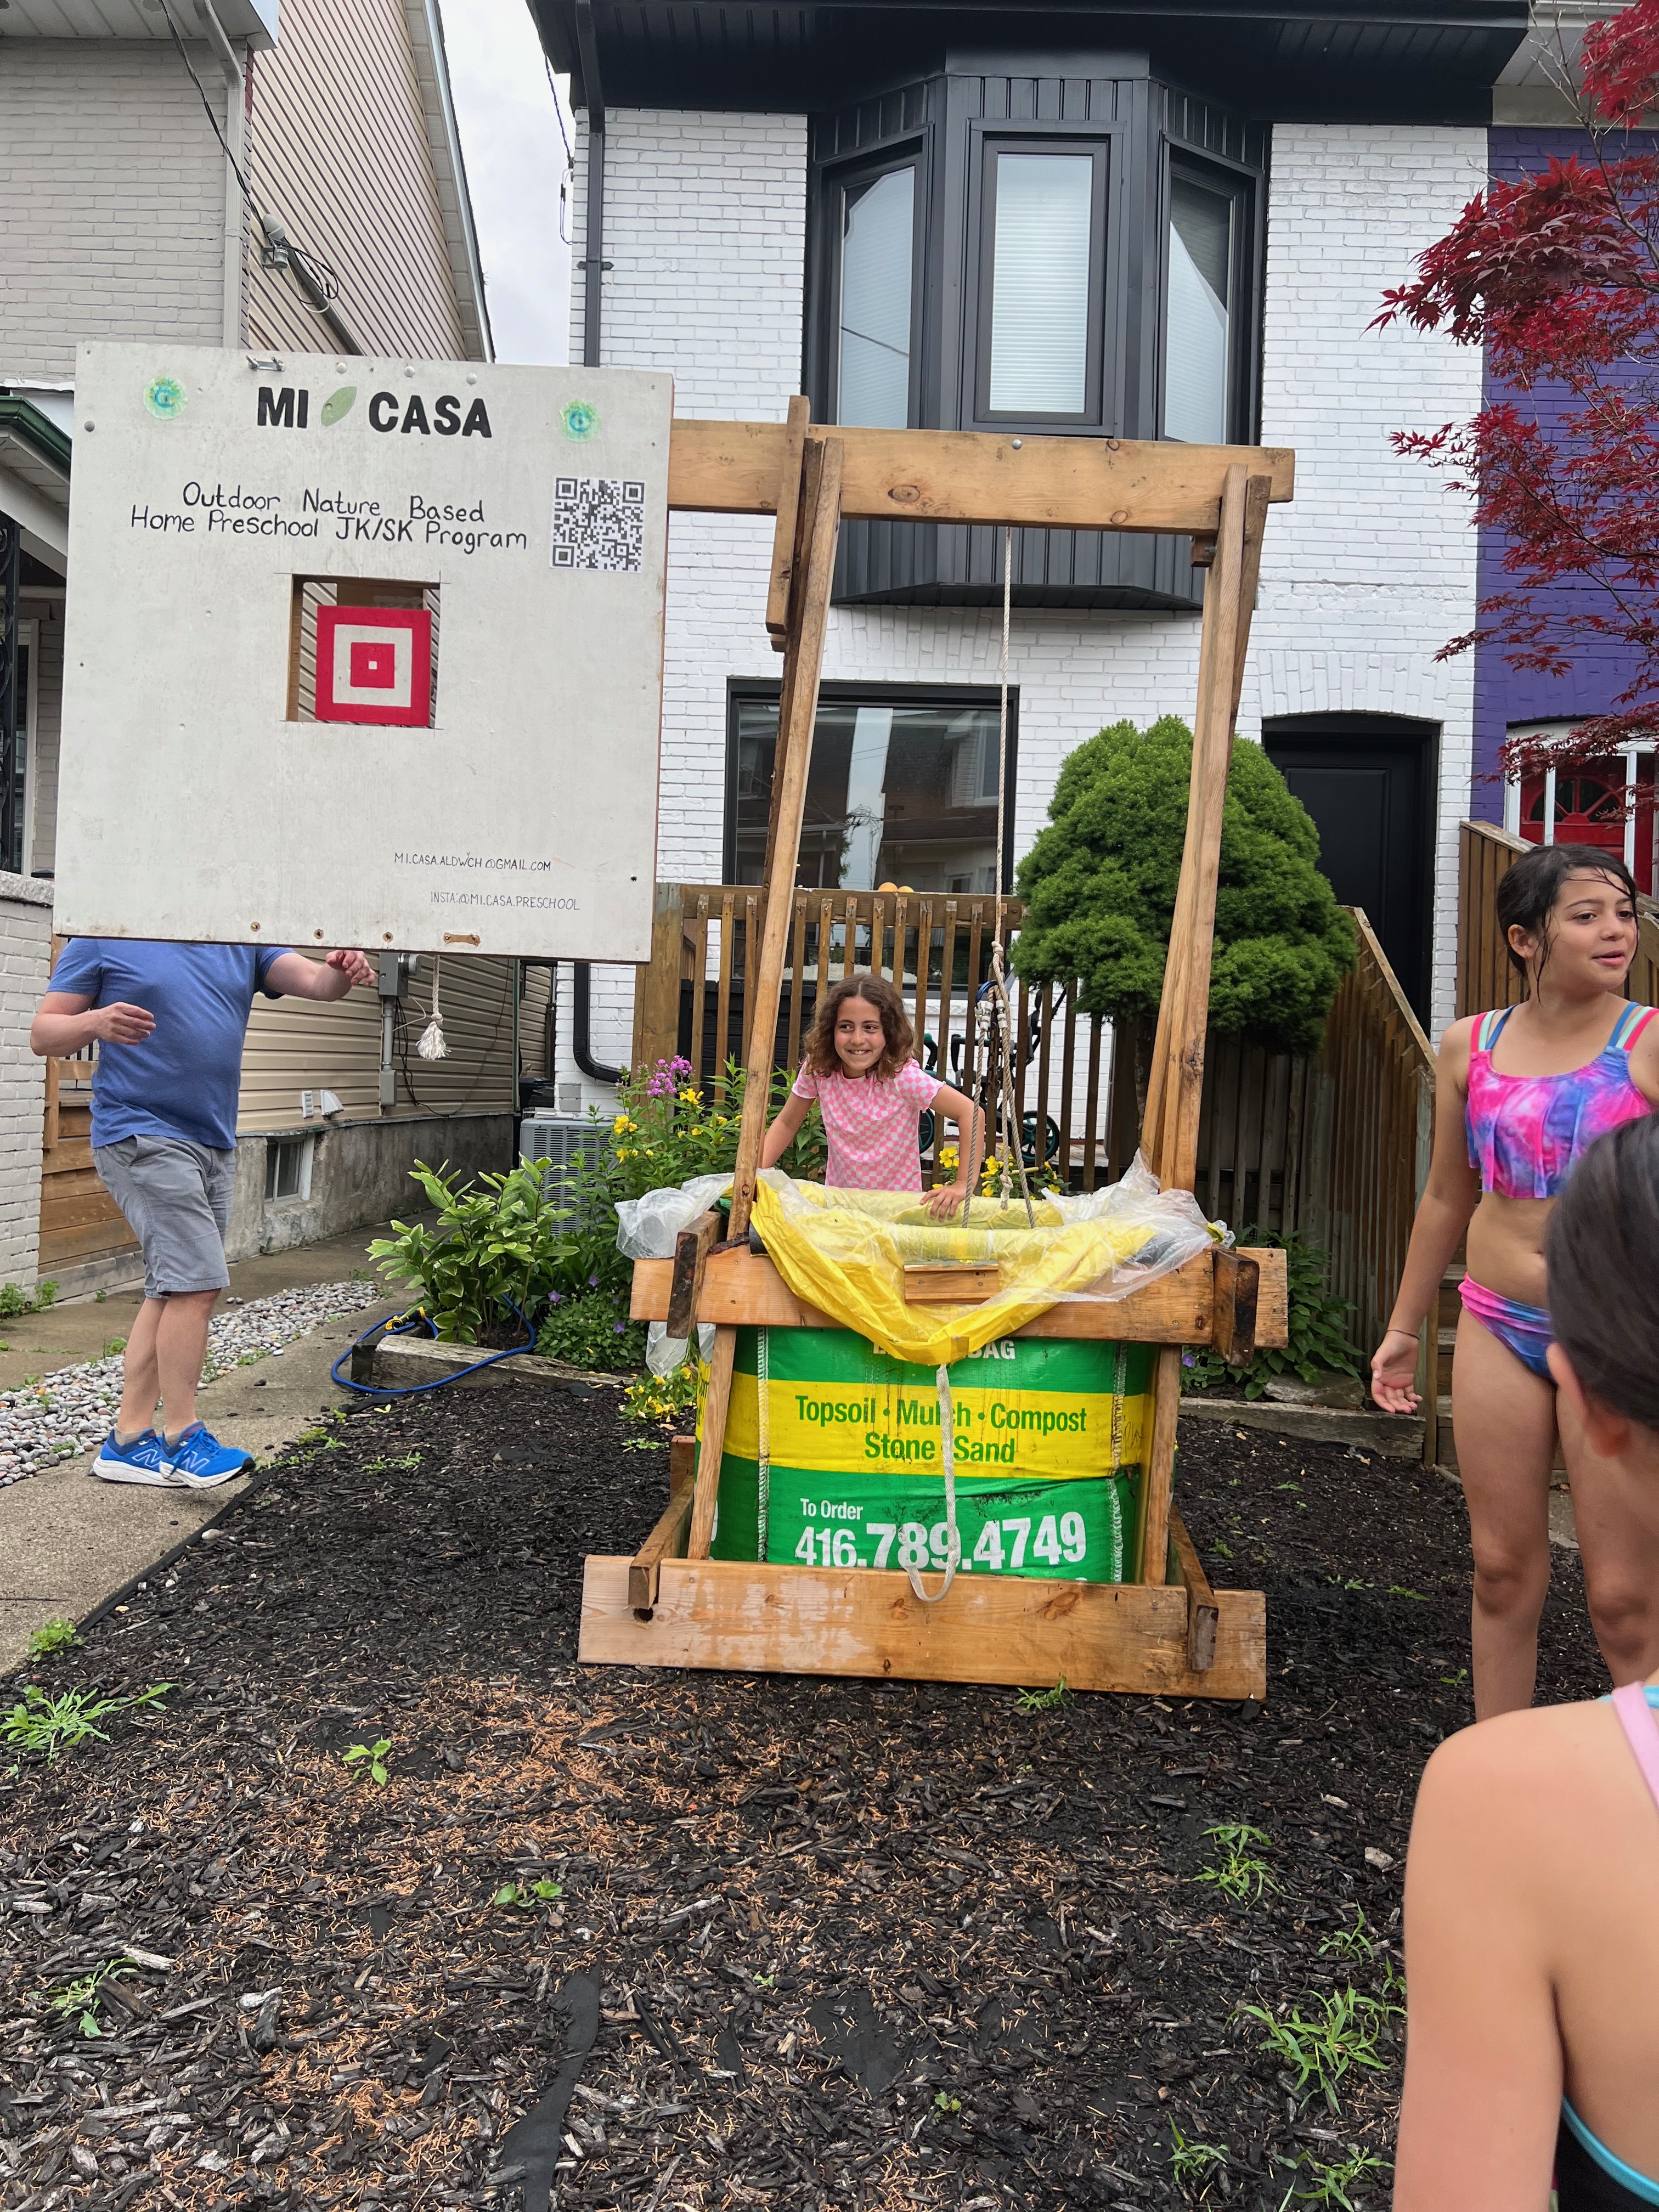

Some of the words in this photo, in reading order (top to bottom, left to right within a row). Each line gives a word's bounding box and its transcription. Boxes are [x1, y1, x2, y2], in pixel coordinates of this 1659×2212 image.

[257, 386, 309, 430] MI
[368, 391, 493, 439] CASA
[182, 481, 281, 513] Outdoor
[302, 487, 381, 517] Nature
[409, 494, 486, 523] Based
[131, 504, 195, 533] Home
[207, 508, 319, 538] Preschool
[335, 516, 414, 543] JK/SK
[425, 520, 527, 556] Program
[794, 1395, 876, 1427] Topsoil
[895, 1398, 971, 1427] Mulh
[990, 1402, 1087, 1437] Compost
[864, 1431, 935, 1460] Stone
[953, 1435, 1015, 1464] Sand
[800, 1498, 817, 1520] To
[821, 1499, 864, 1520] Order
